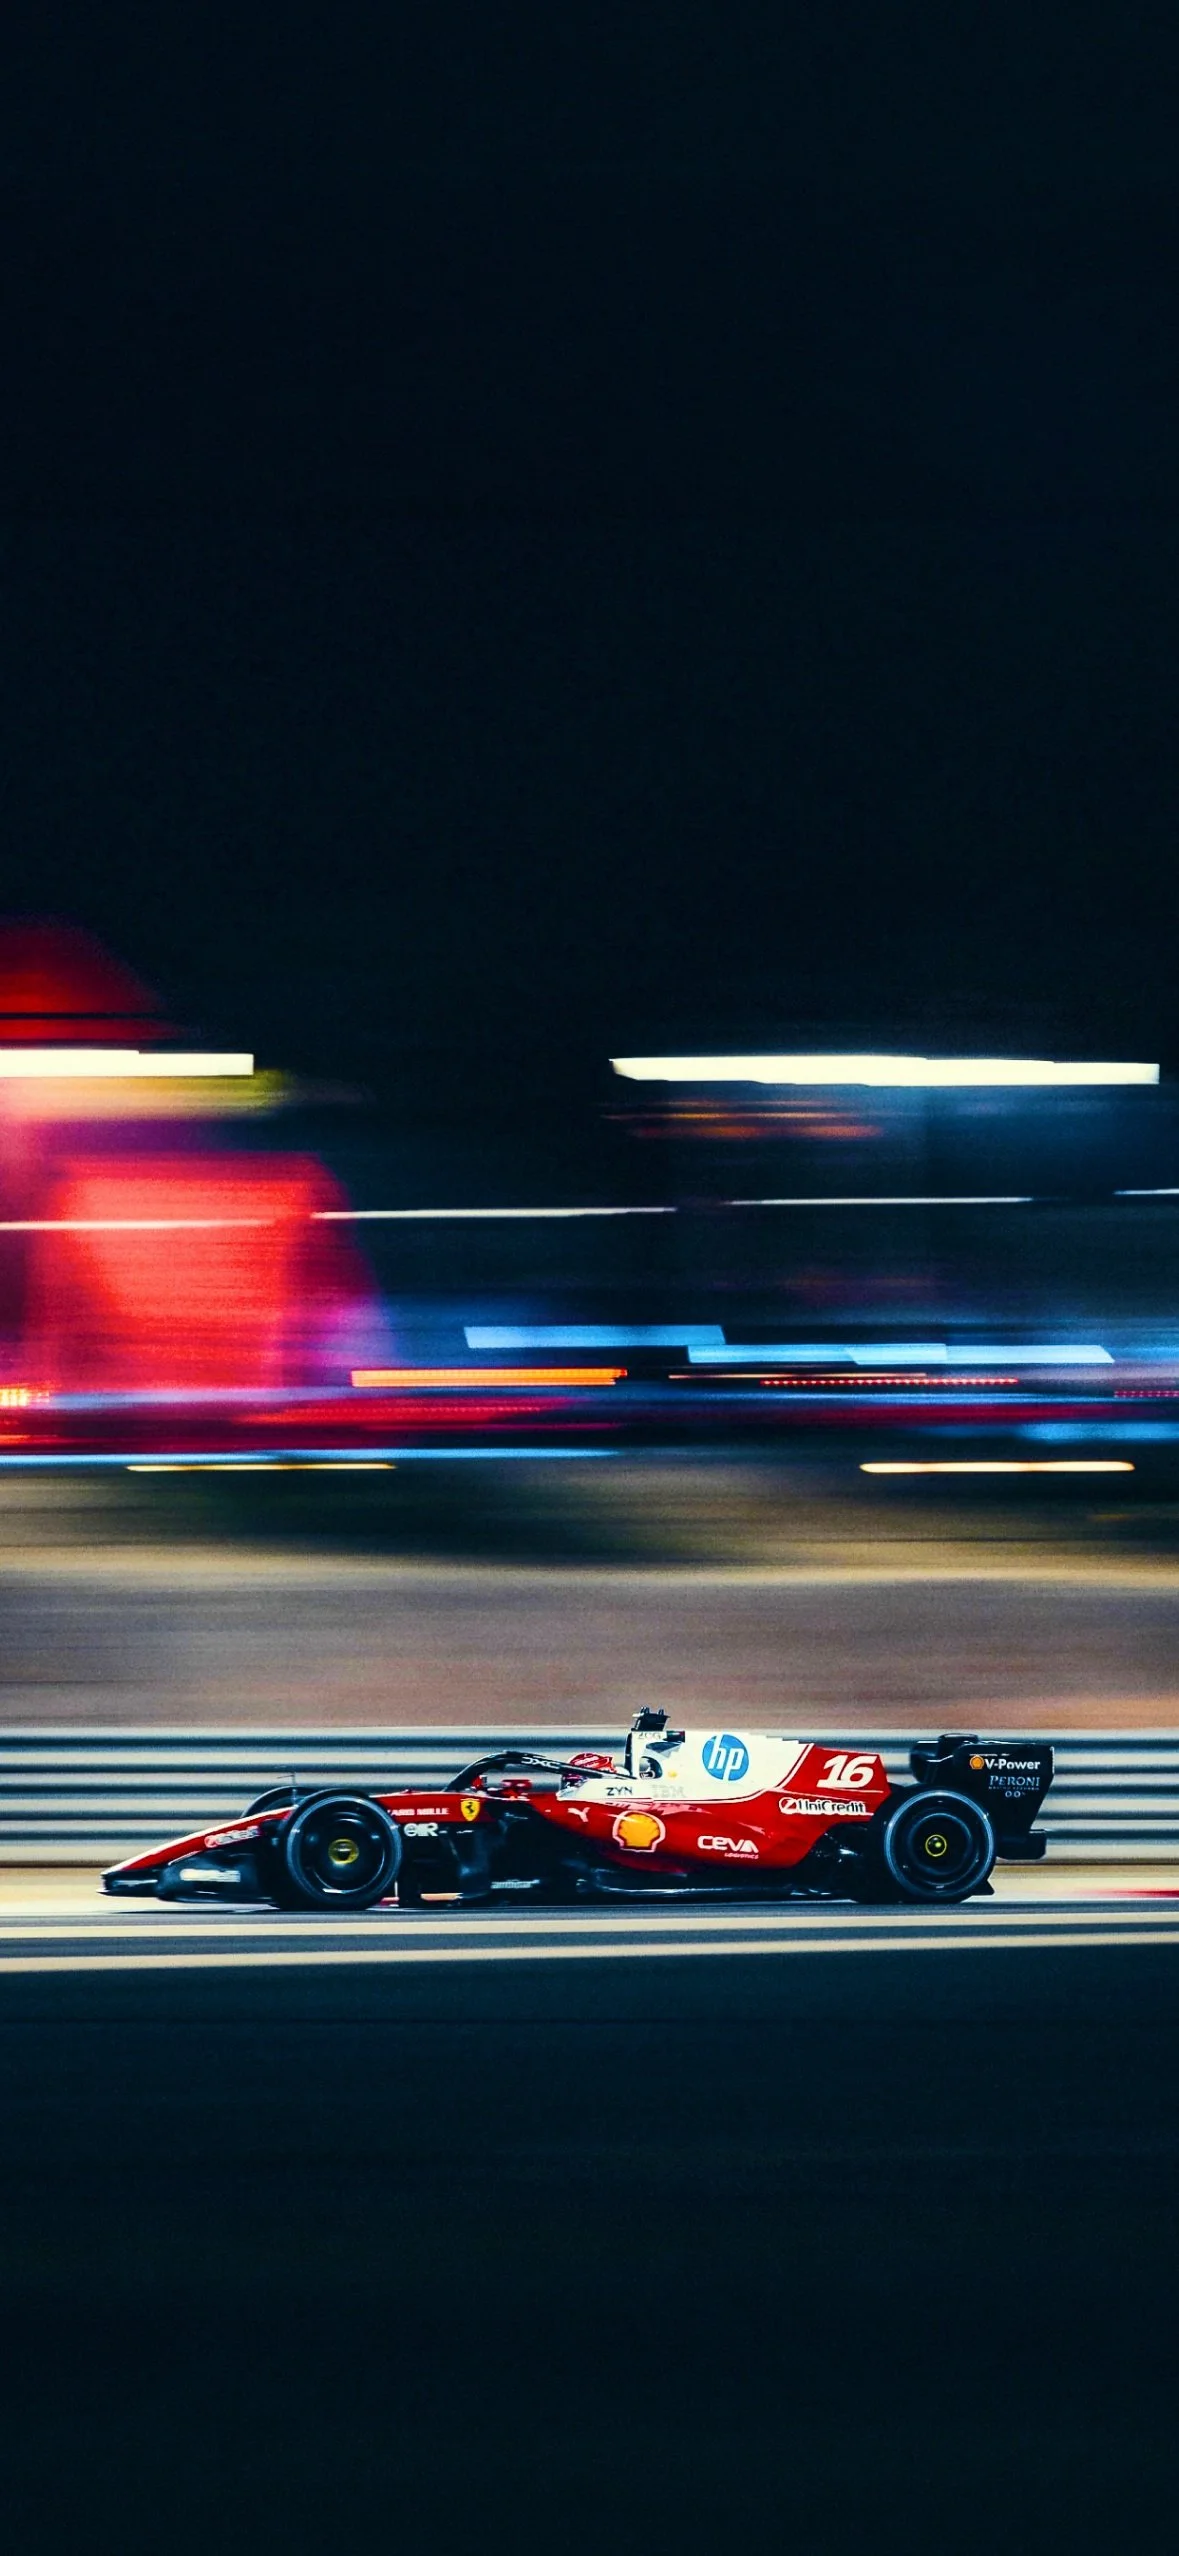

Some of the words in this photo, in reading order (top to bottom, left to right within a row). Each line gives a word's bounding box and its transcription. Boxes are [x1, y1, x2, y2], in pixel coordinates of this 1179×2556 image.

[706, 1734, 745, 1781] hp
[984, 1758, 1041, 1770] V-Power
[816, 1755, 878, 1788] 16
[989, 1775, 1041, 1786] PERONI
[605, 1786, 634, 1797] ZYN
[798, 1799, 864, 1813] UniCredit
[697, 1835, 759, 1853] CEVA
